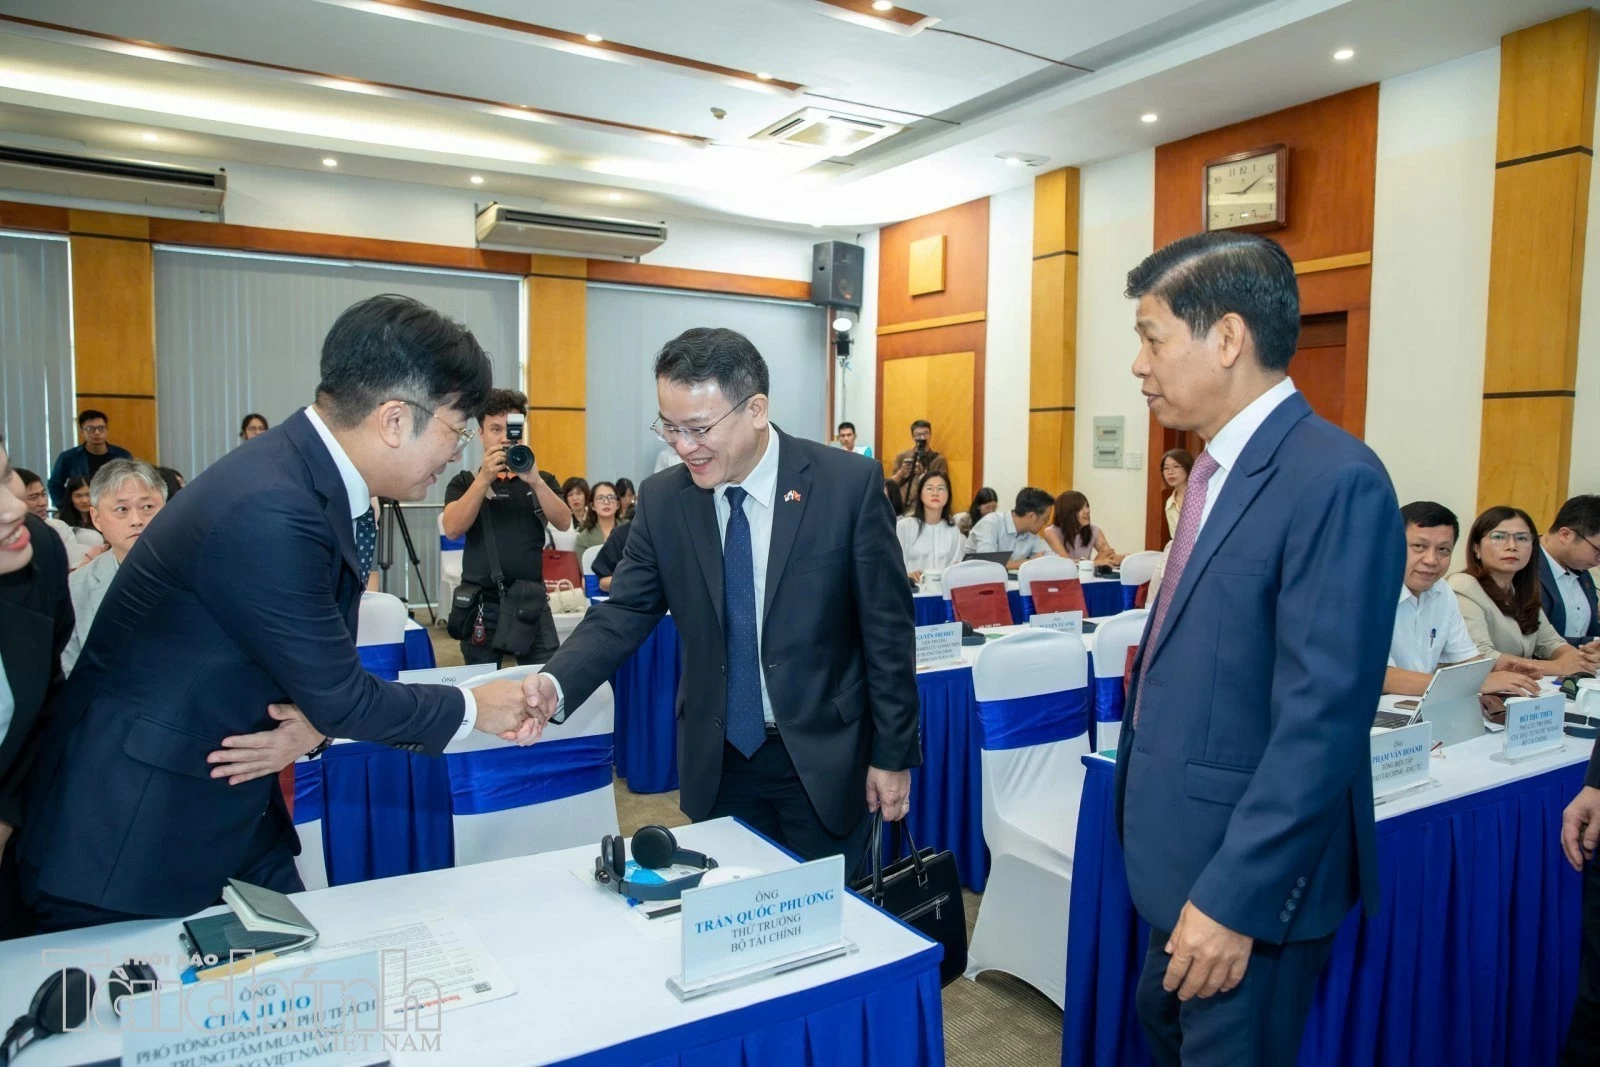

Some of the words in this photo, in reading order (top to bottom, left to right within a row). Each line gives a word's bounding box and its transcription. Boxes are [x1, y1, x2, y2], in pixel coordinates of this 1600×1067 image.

[755, 889, 779, 903] ÔNG
[694, 913, 733, 934] TRẦN
[737, 903, 776, 924] QUỐC
[779, 889, 834, 913] PHƯƠNG
[731, 939, 746, 953] BỘ
[750, 935, 766, 948] TÀI
[769, 926, 802, 943] CHÍNH
[239, 984, 277, 1002] ÔNG
[135, 1040, 170, 1065] PHÓ
[226, 1041, 263, 1060] TÂM
[264, 1033, 300, 1051] MUA
[297, 1042, 333, 1060] NAM
